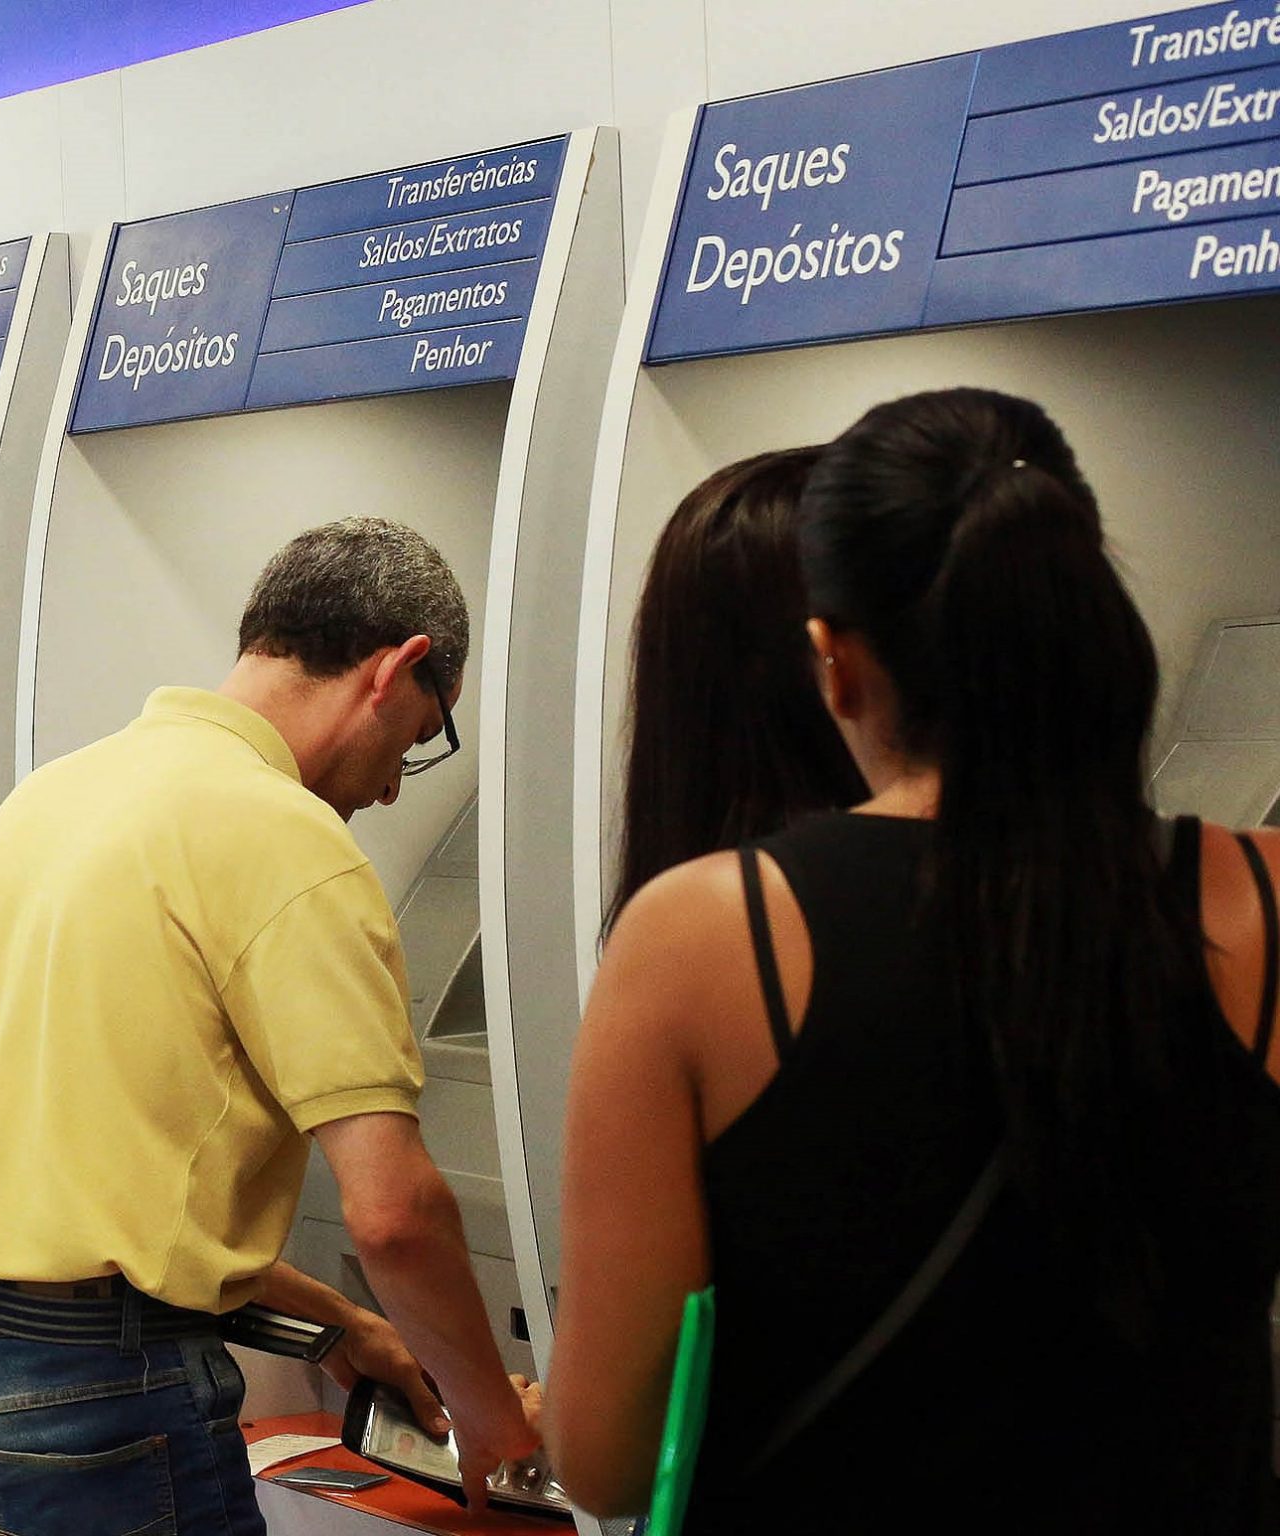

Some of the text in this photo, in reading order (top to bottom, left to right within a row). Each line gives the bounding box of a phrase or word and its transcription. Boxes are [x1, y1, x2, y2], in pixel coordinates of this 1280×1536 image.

[387, 155, 538, 209] Transferências
[707, 143, 851, 211] Saques
[1132, 166, 1280, 222] Pagamen
[358, 216, 523, 270] Saldos/Extratos
[685, 223, 905, 305] Depósitos
[1189, 229, 1280, 280] Penh
[115, 260, 209, 316] Saques
[379, 278, 509, 329] Pagamentos
[98, 326, 239, 391] Depósitos
[410, 337, 493, 374] Penhor
